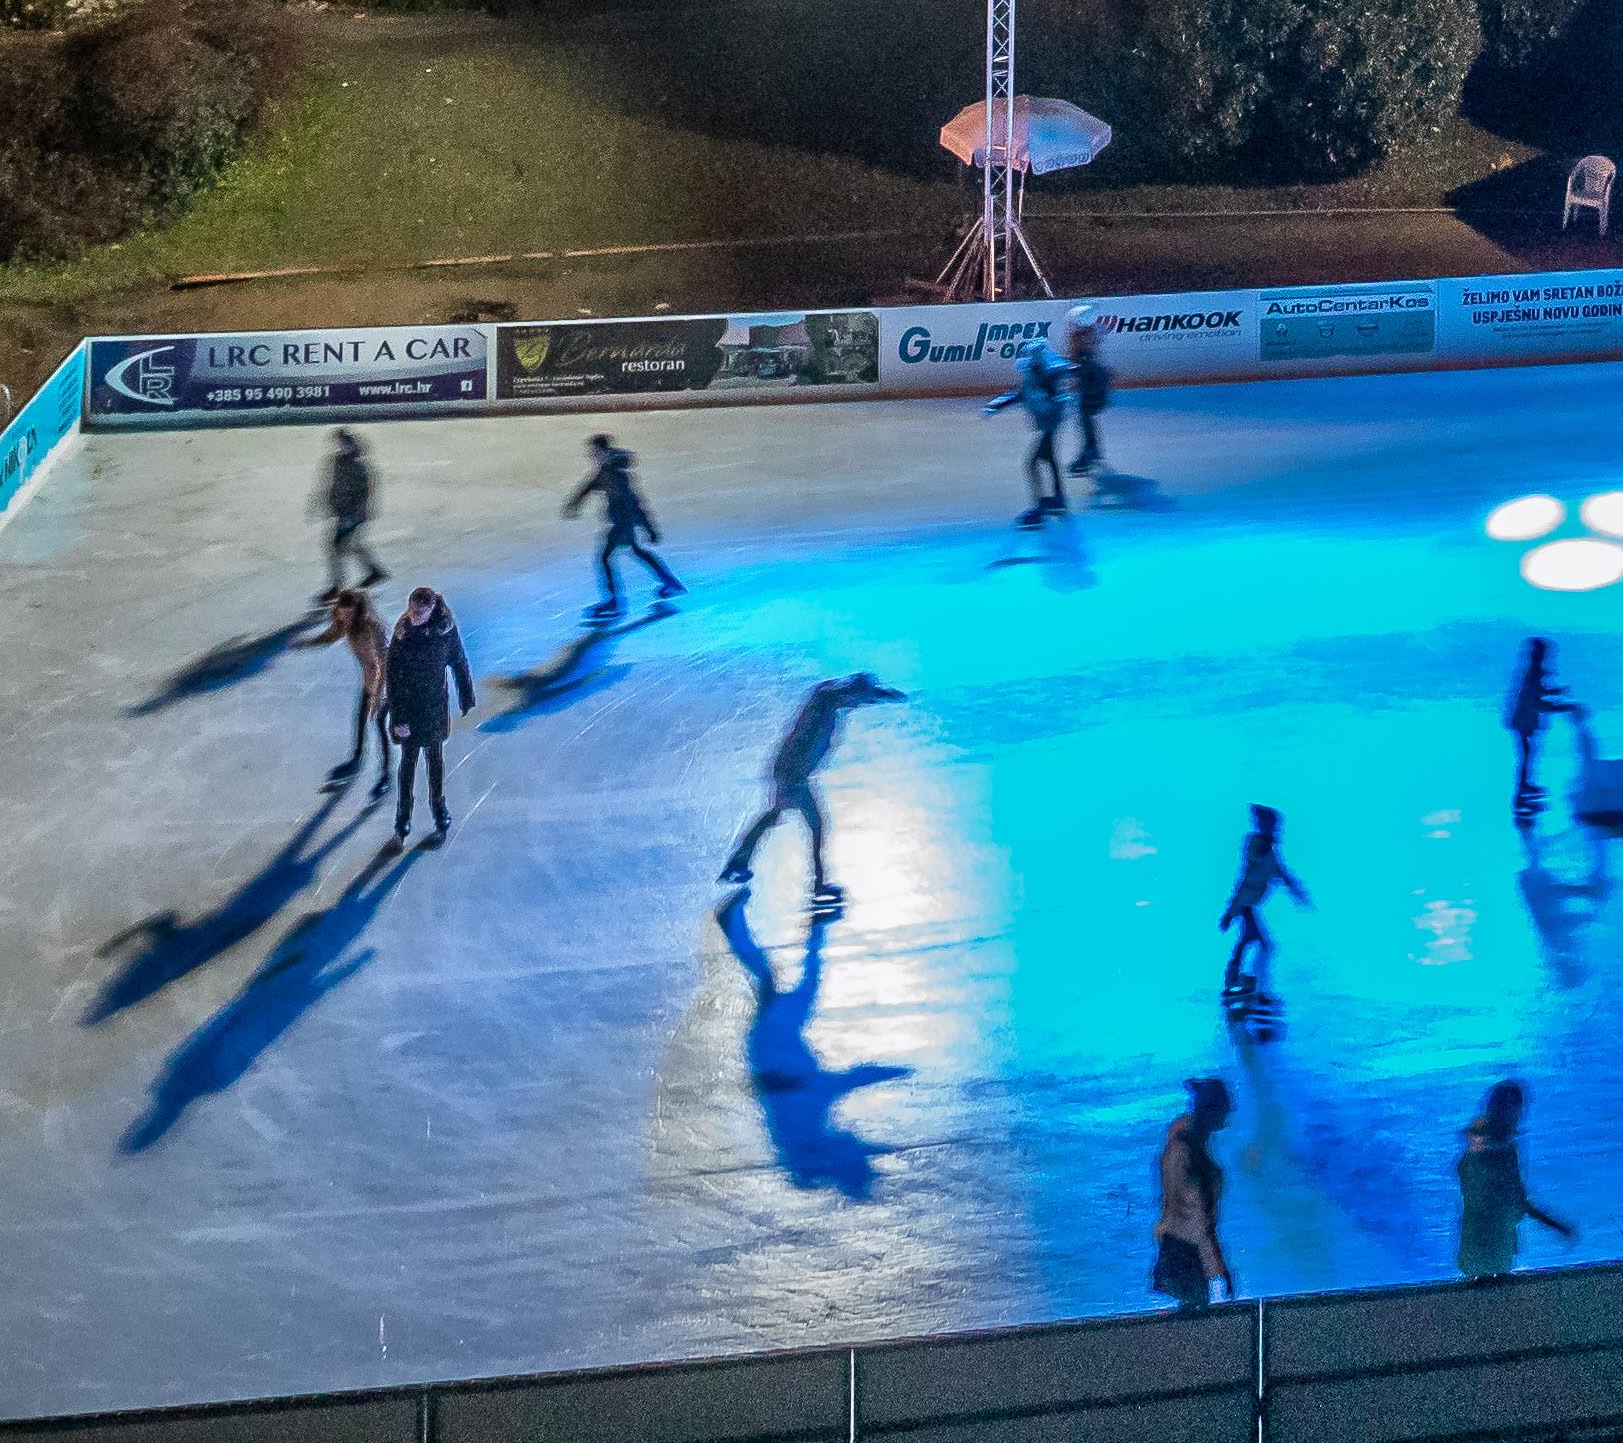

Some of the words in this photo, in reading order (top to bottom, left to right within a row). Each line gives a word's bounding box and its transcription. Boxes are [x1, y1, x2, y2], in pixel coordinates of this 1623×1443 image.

[1462, 289, 1510, 306] ŽELIMO
[1512, 289, 1541, 303] VAM
[1542, 285, 1595, 301] SRETAN
[1543, 305, 1580, 321] NOVU
[208, 344, 272, 368] LRC
[282, 341, 366, 365] RENT
[373, 340, 397, 361] A
[405, 337, 472, 360] CAR
[621, 359, 686, 373] restoran
[244, 387, 264, 401] 95
[295, 385, 330, 399] 3981
